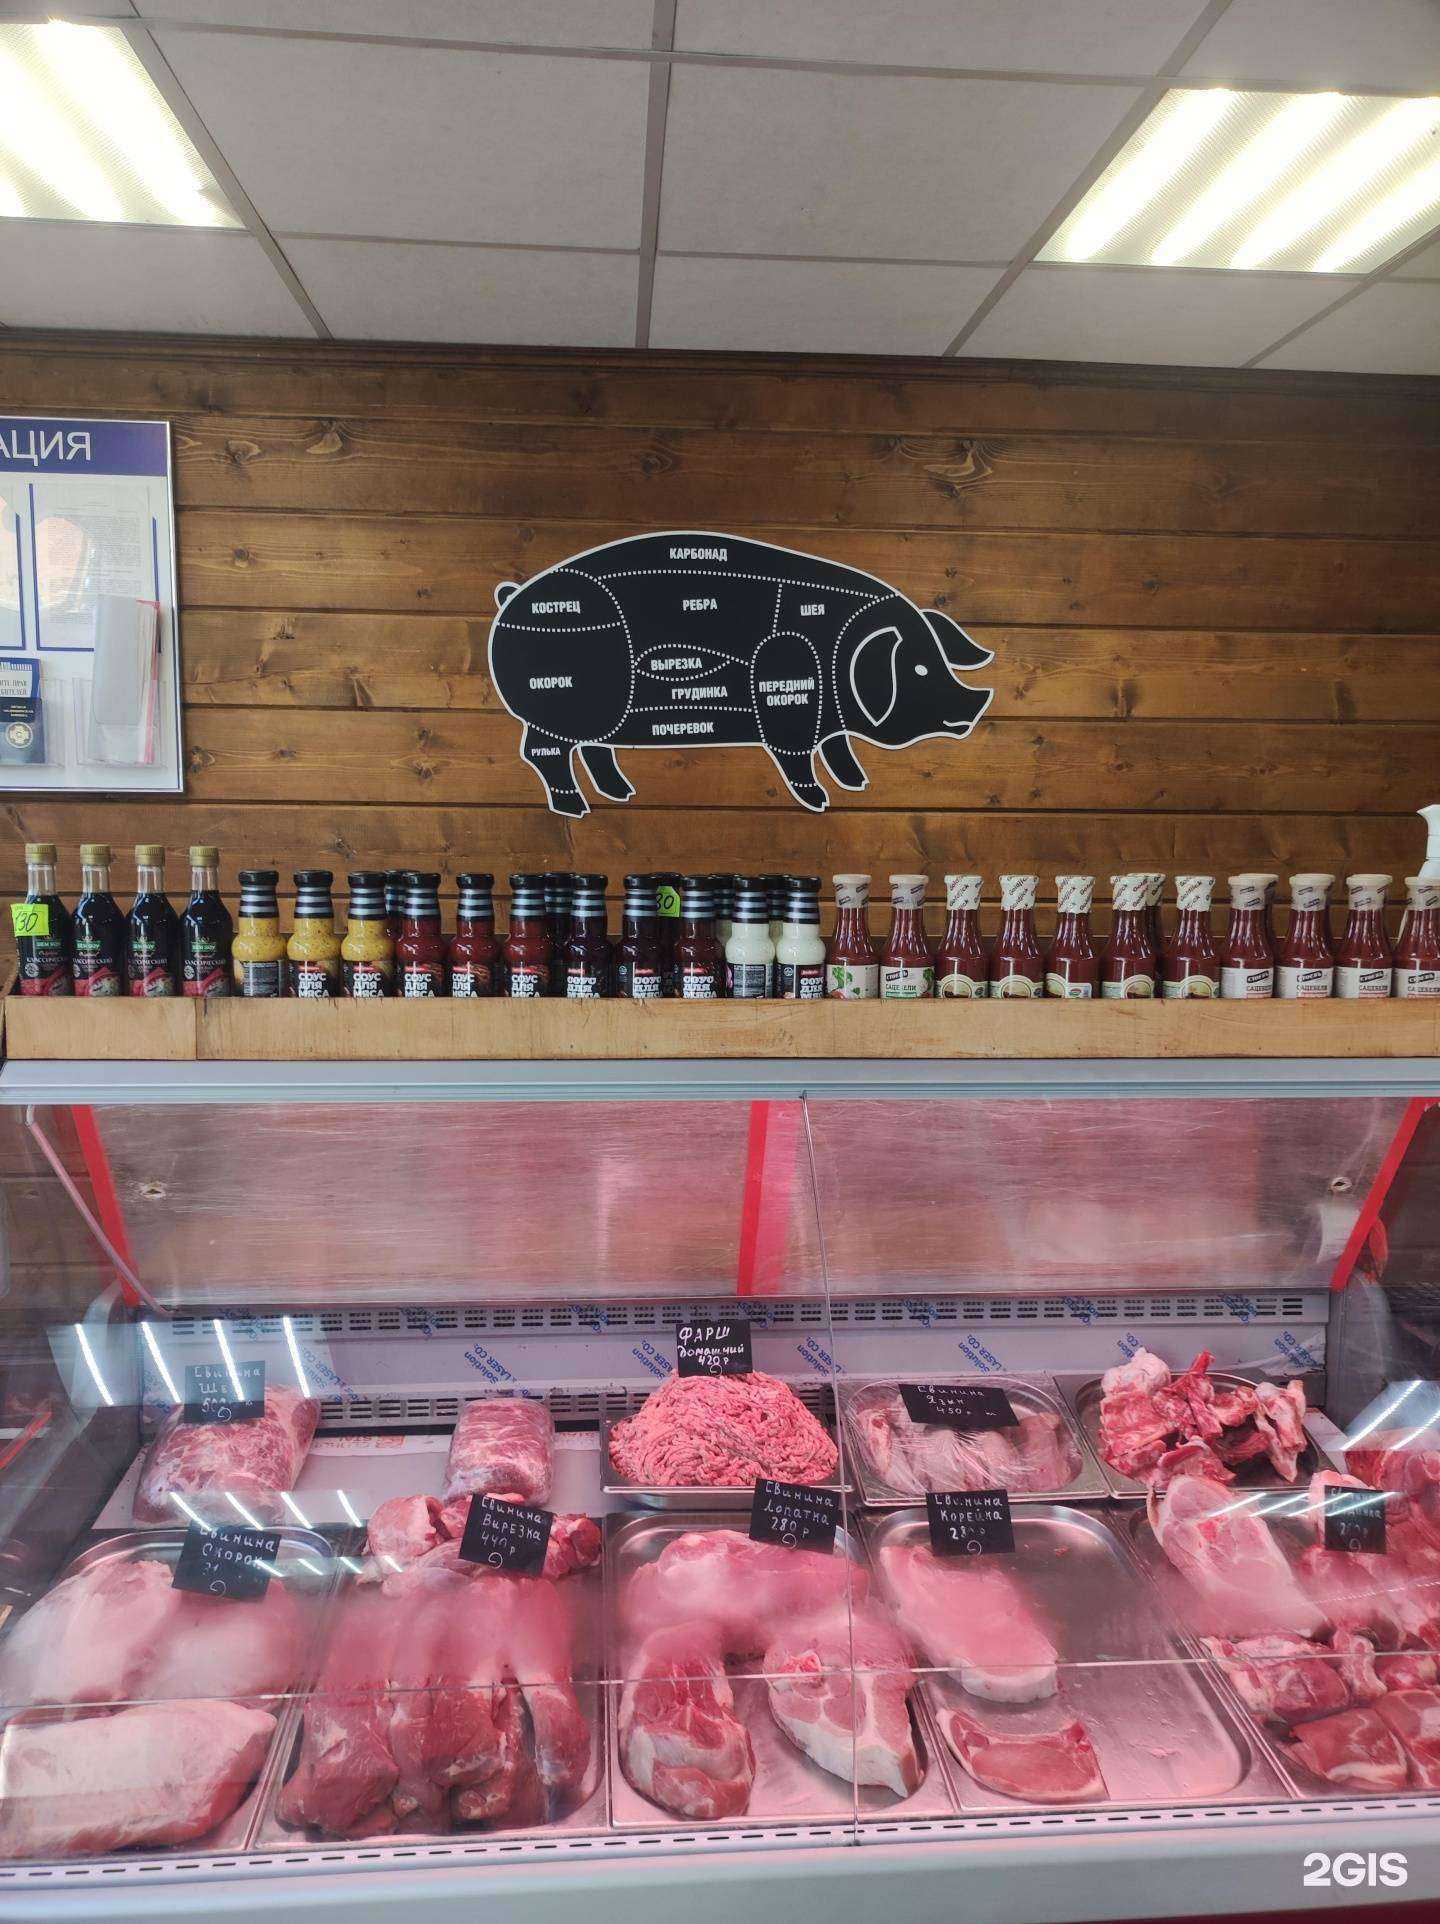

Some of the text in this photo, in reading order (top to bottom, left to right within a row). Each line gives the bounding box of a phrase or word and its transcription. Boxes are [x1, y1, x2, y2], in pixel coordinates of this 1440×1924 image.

[669, 548, 728, 562] КАРБОНАД
[531, 600, 581, 614] КОСТРЕЦ
[682, 598, 718, 611] РЕБРА
[800, 604, 825, 616] ШЕЯ
[650, 657, 703, 671] ВЫРЕЗКА
[529, 676, 573, 690] ОКОРОК
[758, 677, 815, 692] ПЕРЕДНИЙ
[671, 686, 728, 700] ГРУДИНКА
[766, 693, 809, 706] ОКОРОК
[651, 722, 714, 736] ПОЧЕРЕВОК
[531, 747, 561, 757] РУЛЬКА
[679, 1326, 731, 1345] ФАРШ
[632, 1348, 665, 1380] Solution
[698, 1355, 720, 1366] 420
[797, 1345, 829, 1377] Solution
[959, 1342, 990, 1374] Solution
[464, 1351, 498, 1384] Solution
[487, 1356, 511, 1381] LASER
